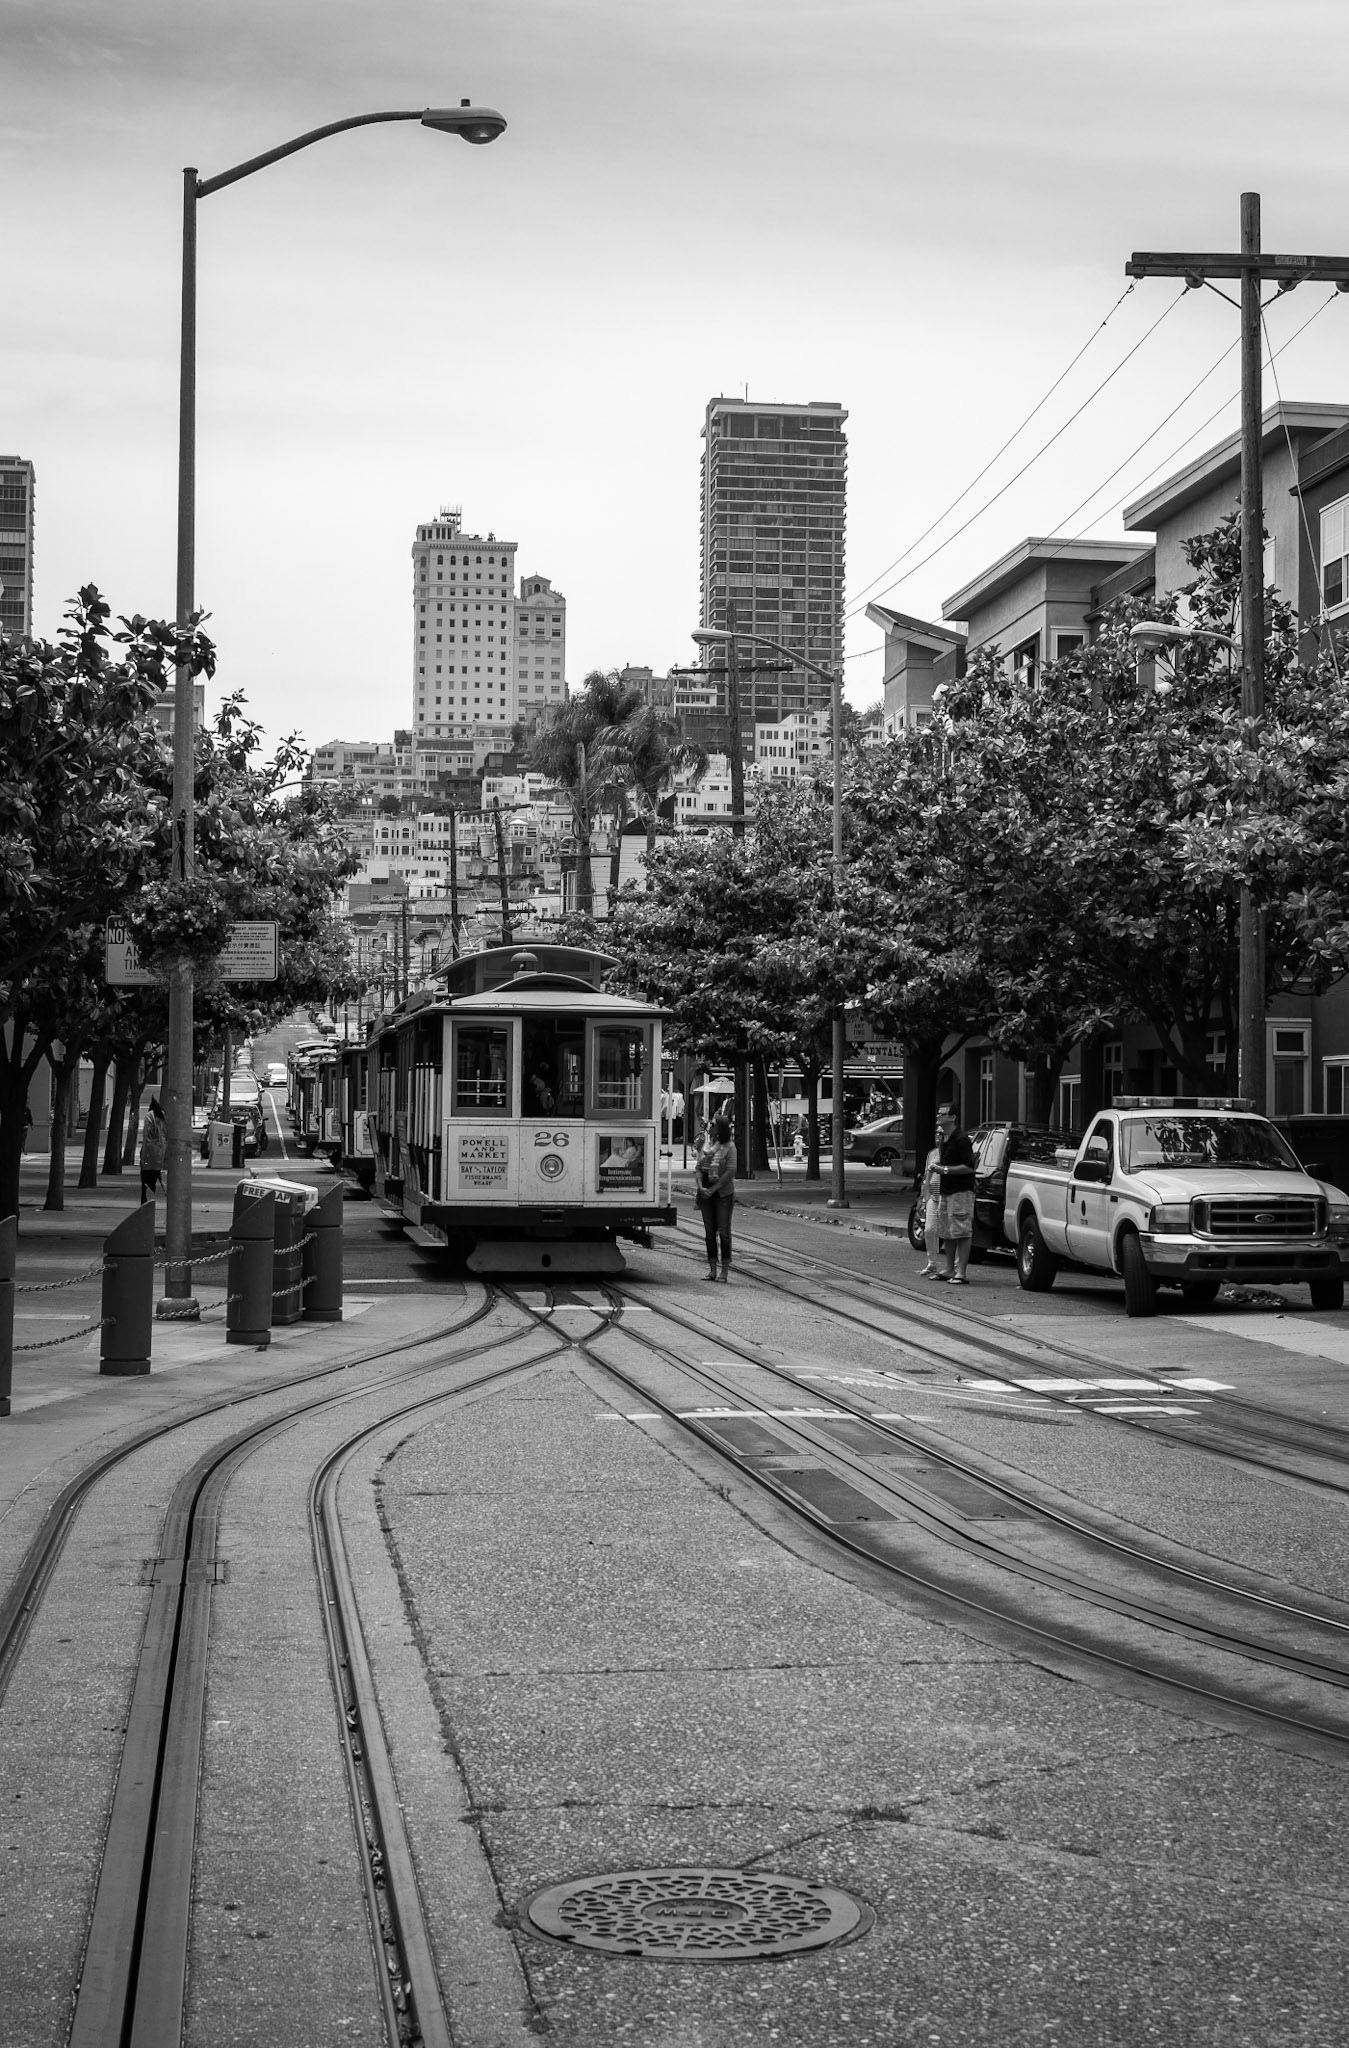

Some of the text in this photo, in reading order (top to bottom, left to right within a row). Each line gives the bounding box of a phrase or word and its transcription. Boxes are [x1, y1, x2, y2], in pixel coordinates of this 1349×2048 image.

[108, 928, 124, 944] NO
[462, 1139, 506, 1147] POWELL
[534, 1131, 570, 1148] 26
[461, 1151, 506, 1159] MARKET
[460, 1165, 473, 1174] BAY
[483, 1165, 506, 1174] TAYLOR
[243, 1186, 265, 1197] FREE
